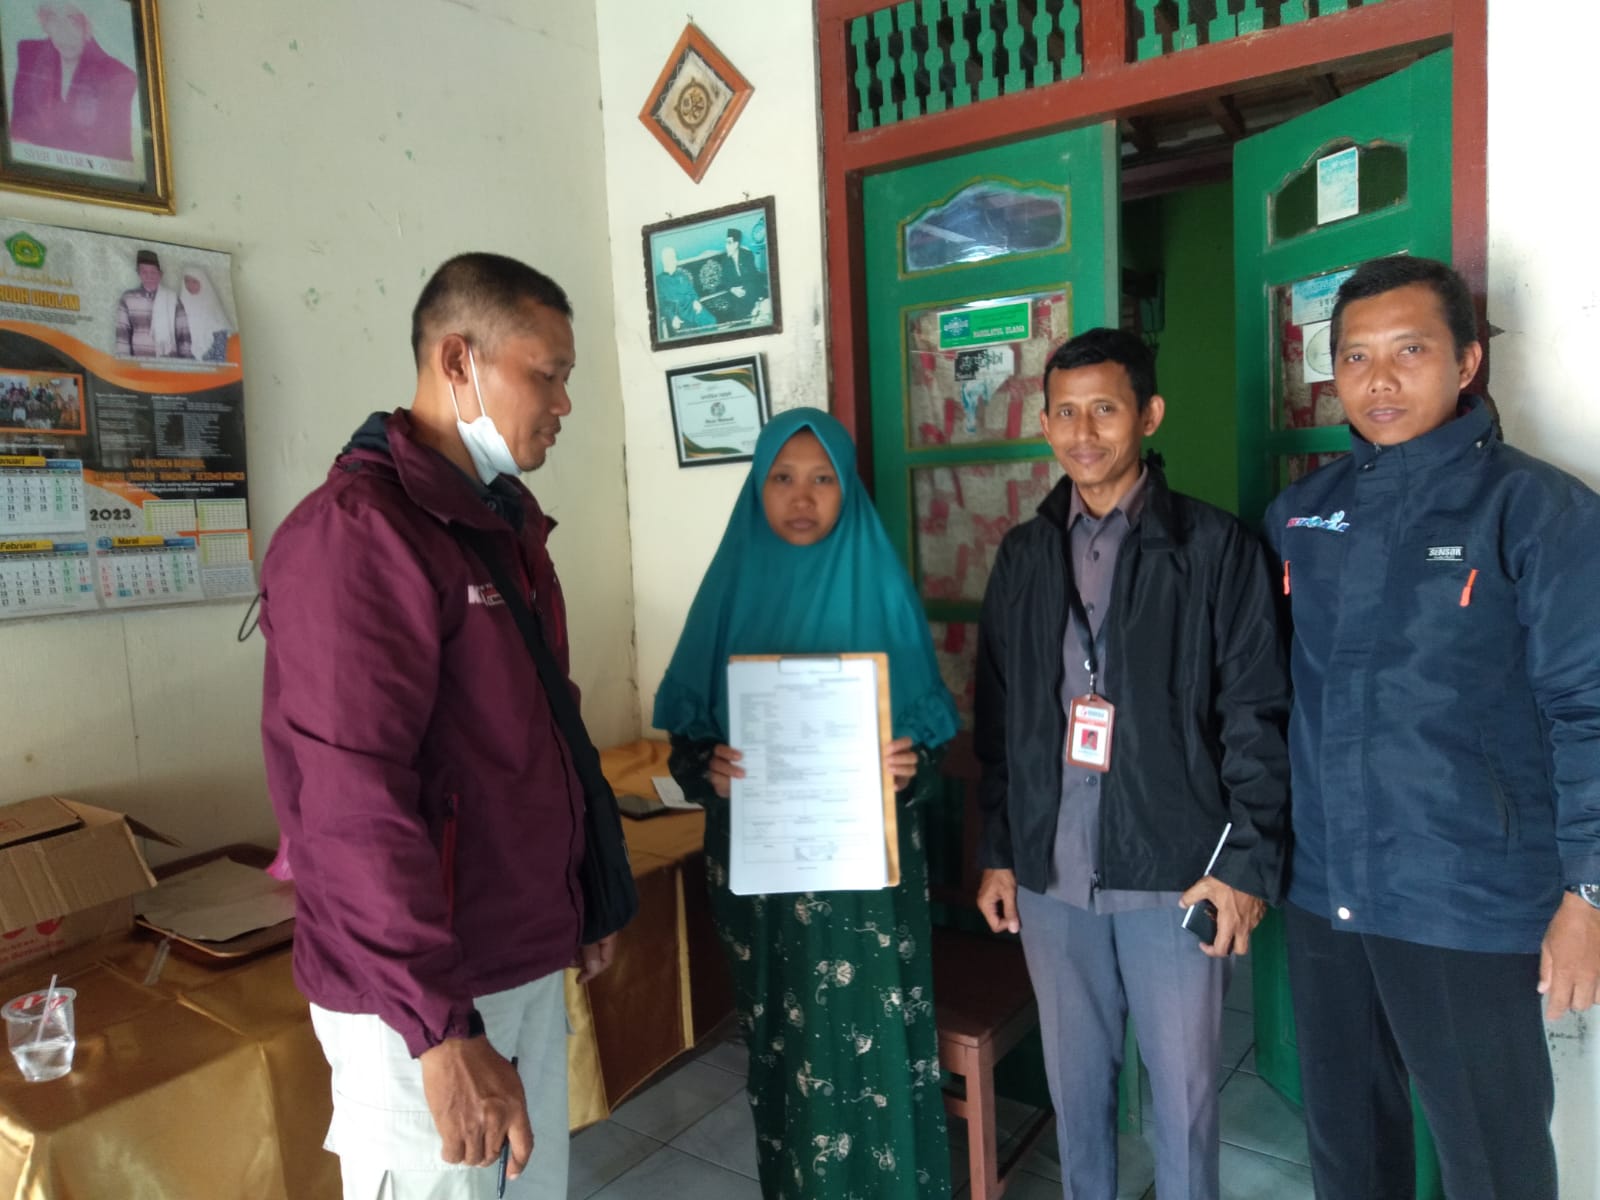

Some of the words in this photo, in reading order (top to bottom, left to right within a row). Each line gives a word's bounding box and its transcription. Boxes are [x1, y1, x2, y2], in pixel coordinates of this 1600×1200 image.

[90, 508, 131, 521] 2023
[0, 542, 37, 550] Februari
[1428, 548, 1461, 556] SENSOR
